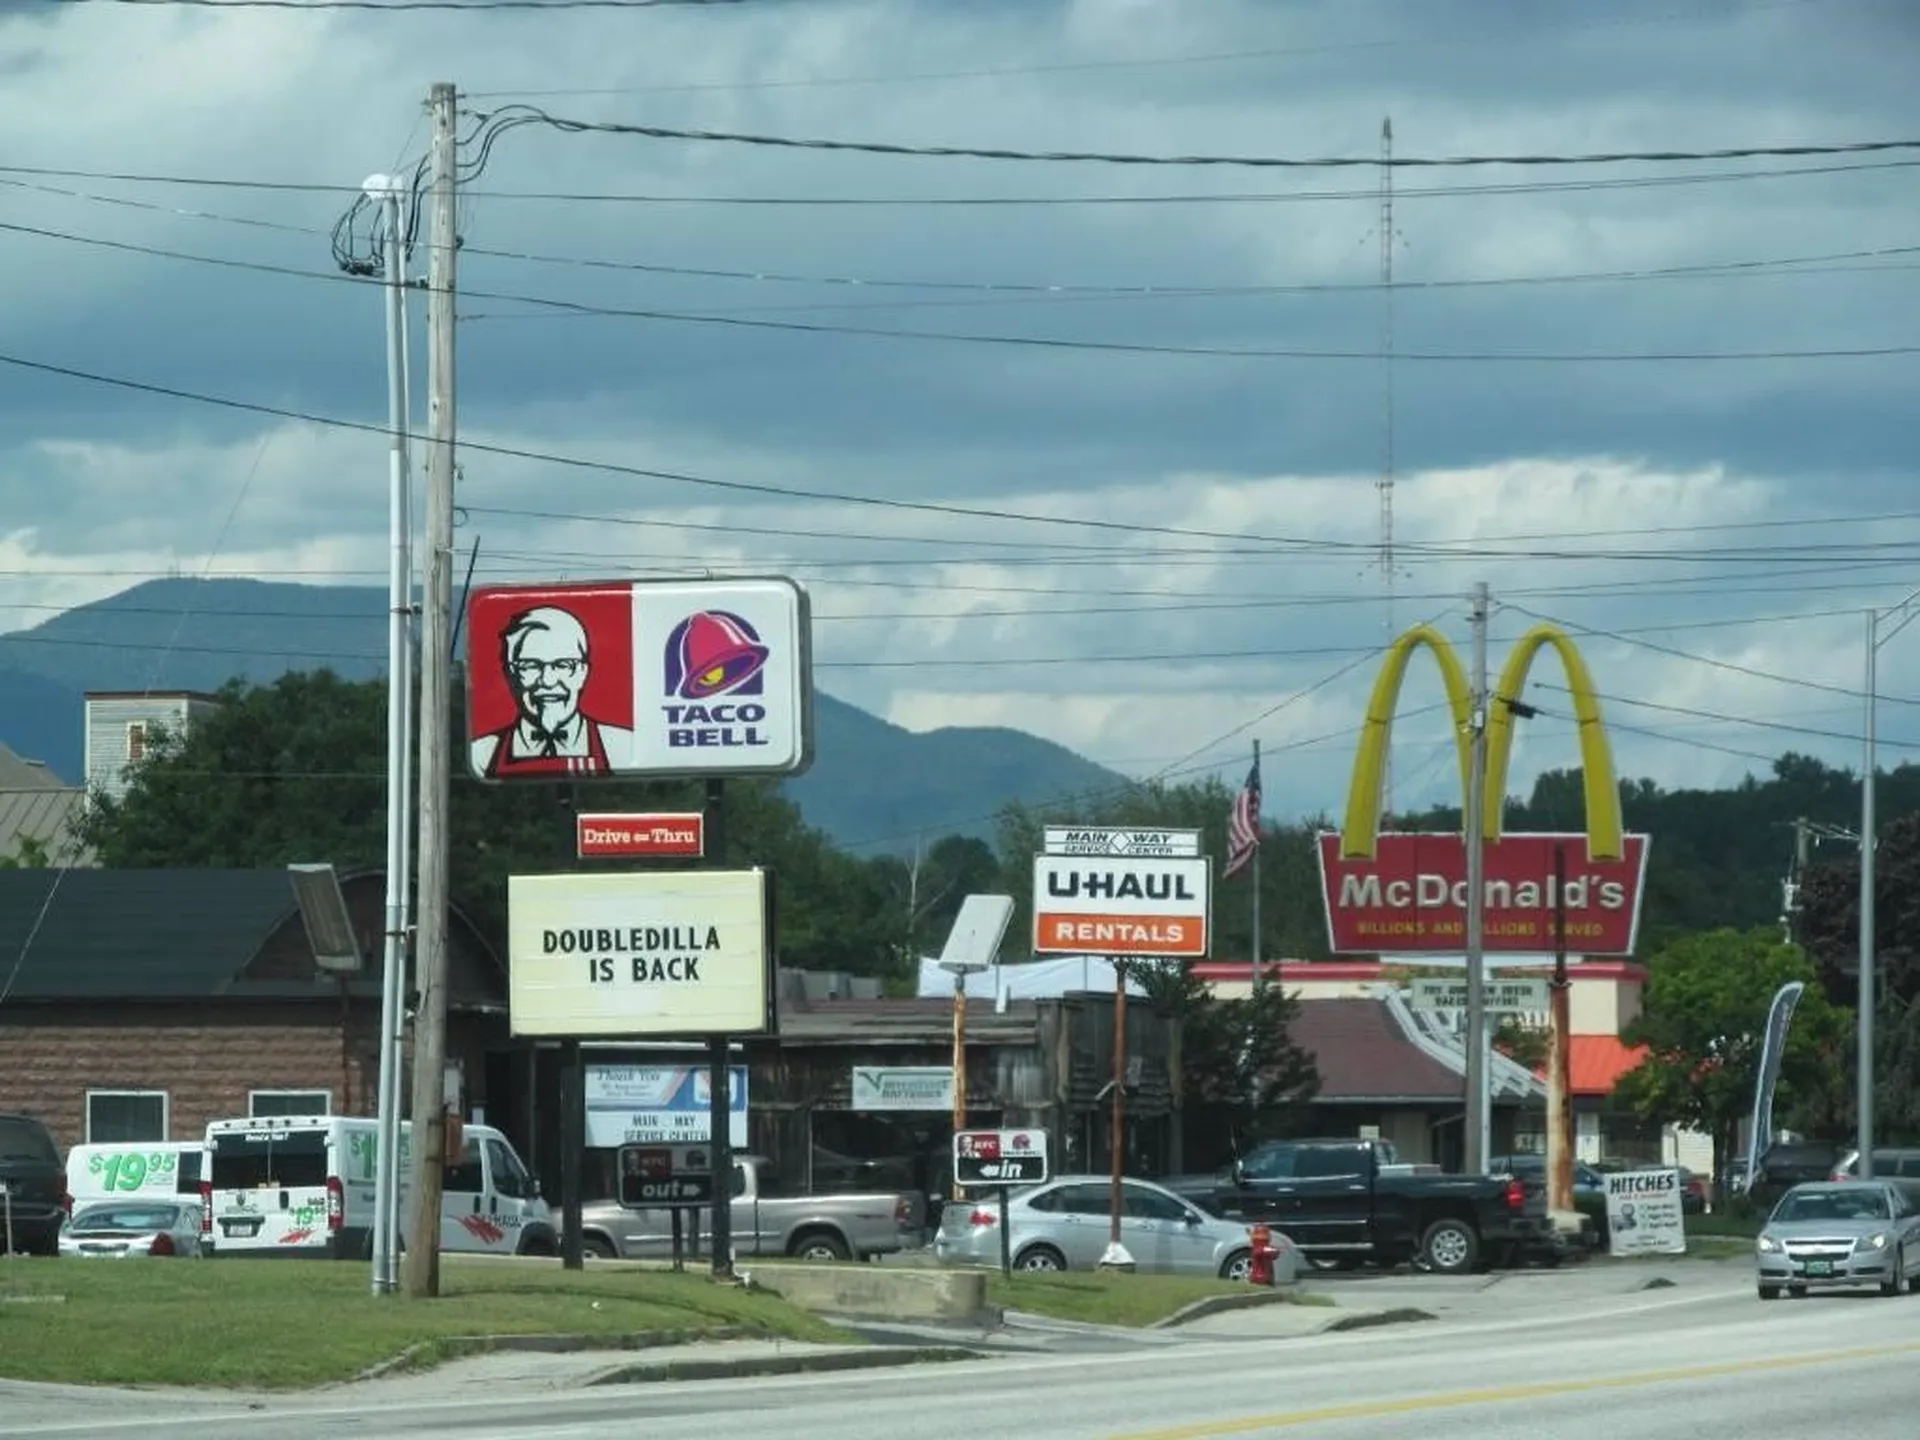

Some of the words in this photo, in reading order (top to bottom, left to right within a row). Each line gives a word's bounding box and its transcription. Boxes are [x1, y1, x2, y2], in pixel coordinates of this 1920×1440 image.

[661, 704, 766, 723] TACO
[668, 727, 769, 748] BELL
[583, 828, 631, 844] Drive
[651, 828, 695, 844] Thru
[1065, 832, 1108, 843] MAIN
[1133, 833, 1171, 844] WAY
[1127, 846, 1173, 856] CENTER
[1048, 871, 1195, 900] U-HAUL
[1338, 874, 1625, 909] McDonald's
[1056, 922, 1184, 943] RENTALS
[1357, 921, 1426, 935] BILLIONS
[1432, 921, 1463, 935] AND
[1484, 921, 1537, 936] LLIONS
[1546, 922, 1605, 936] SRVED
[543, 926, 721, 953] DOUBLEDILLA
[590, 958, 614, 982] IS
[632, 957, 700, 982] BACK
[631, 1114, 659, 1127] MAIN
[674, 1114, 697, 1127] WAY
[624, 1129, 665, 1141] SERVICE
[1000, 1159, 1022, 1178] in
[641, 1180, 680, 1198] out
[1609, 1174, 1675, 1194] HITCHES
